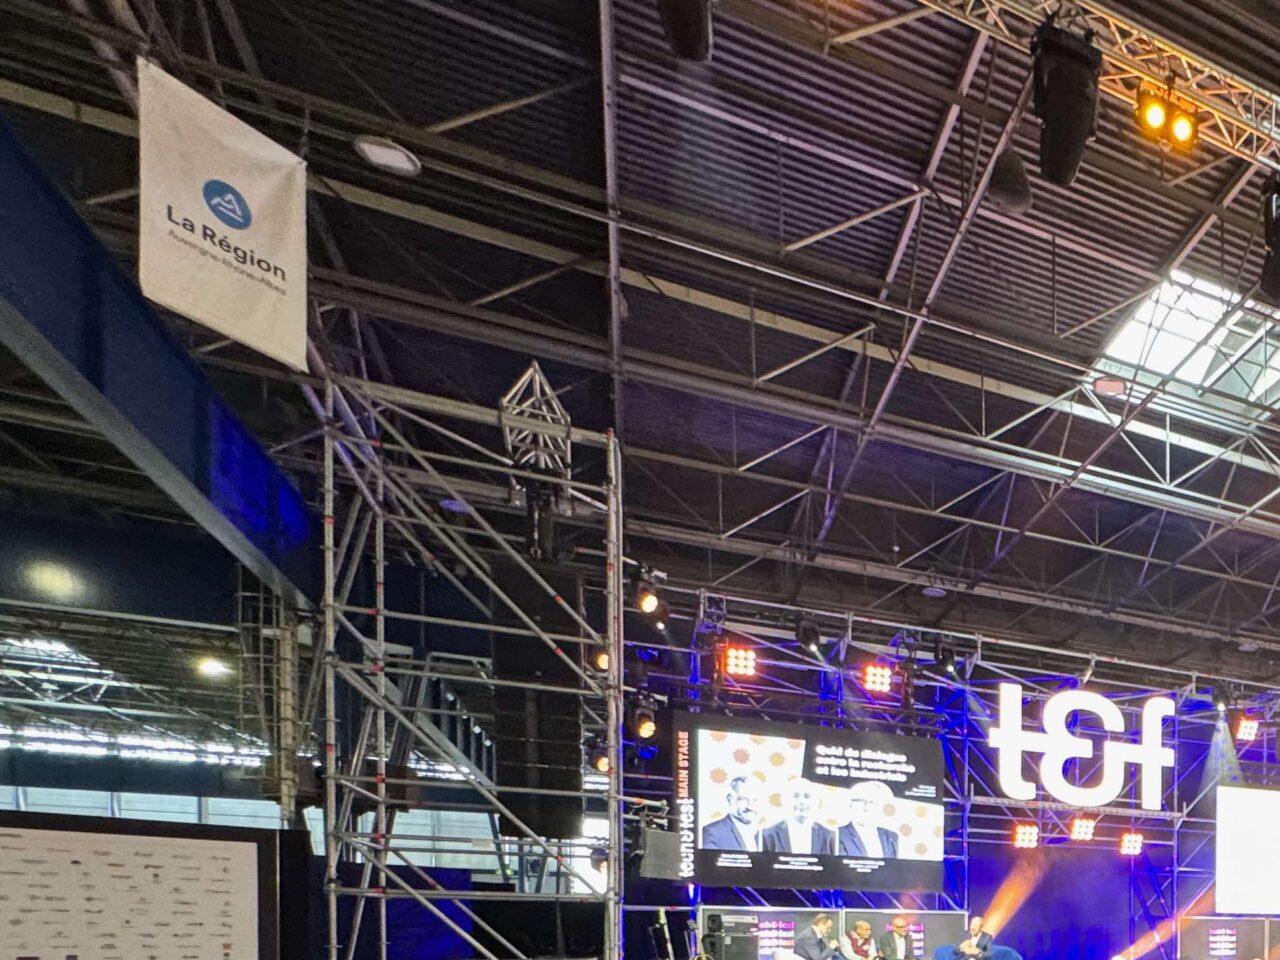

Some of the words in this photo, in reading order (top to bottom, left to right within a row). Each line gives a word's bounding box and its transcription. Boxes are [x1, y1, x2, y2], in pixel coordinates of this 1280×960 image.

[166, 203, 195, 234] La
[202, 224, 287, 282] Région
[678, 731, 689, 767] STAGE
[678, 769, 689, 798] MAIN
